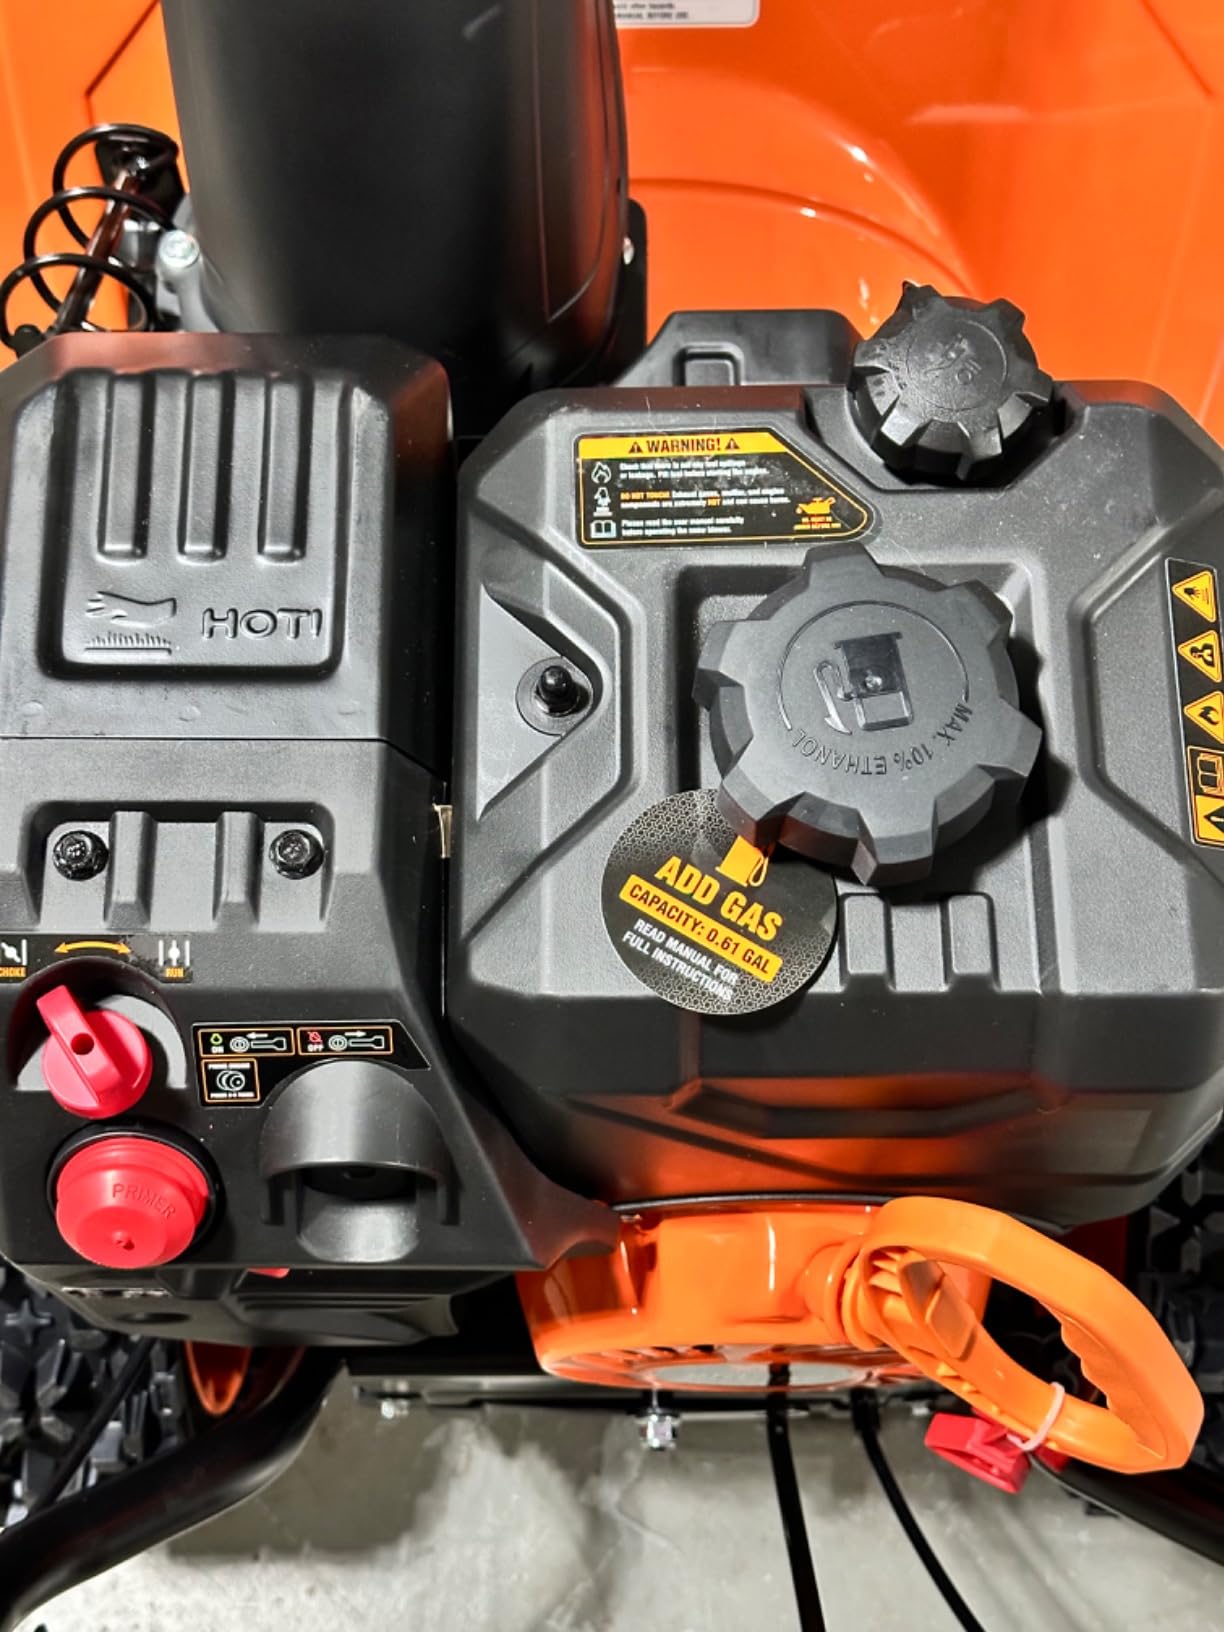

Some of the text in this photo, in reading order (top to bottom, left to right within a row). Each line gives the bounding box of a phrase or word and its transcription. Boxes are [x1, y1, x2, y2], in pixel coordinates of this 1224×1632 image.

[646, 437, 721, 453] WARNING!
[791, 728, 888, 775] ETHANOL
[894, 743, 934, 772] 10%
[654, 856, 783, 941] ADD GAS
[629, 884, 771, 974] CAPACITY: 0.61 GAL
[622, 930, 736, 1002] FULL INSTRUCTIONS
[633, 918, 740, 986] READ MANUAL FOR
[166, 967, 184, 977] RUN
[211, 1046, 224, 1054] ON
[307, 1044, 324, 1052] OFF
[112, 1183, 176, 1219] PRIMER
